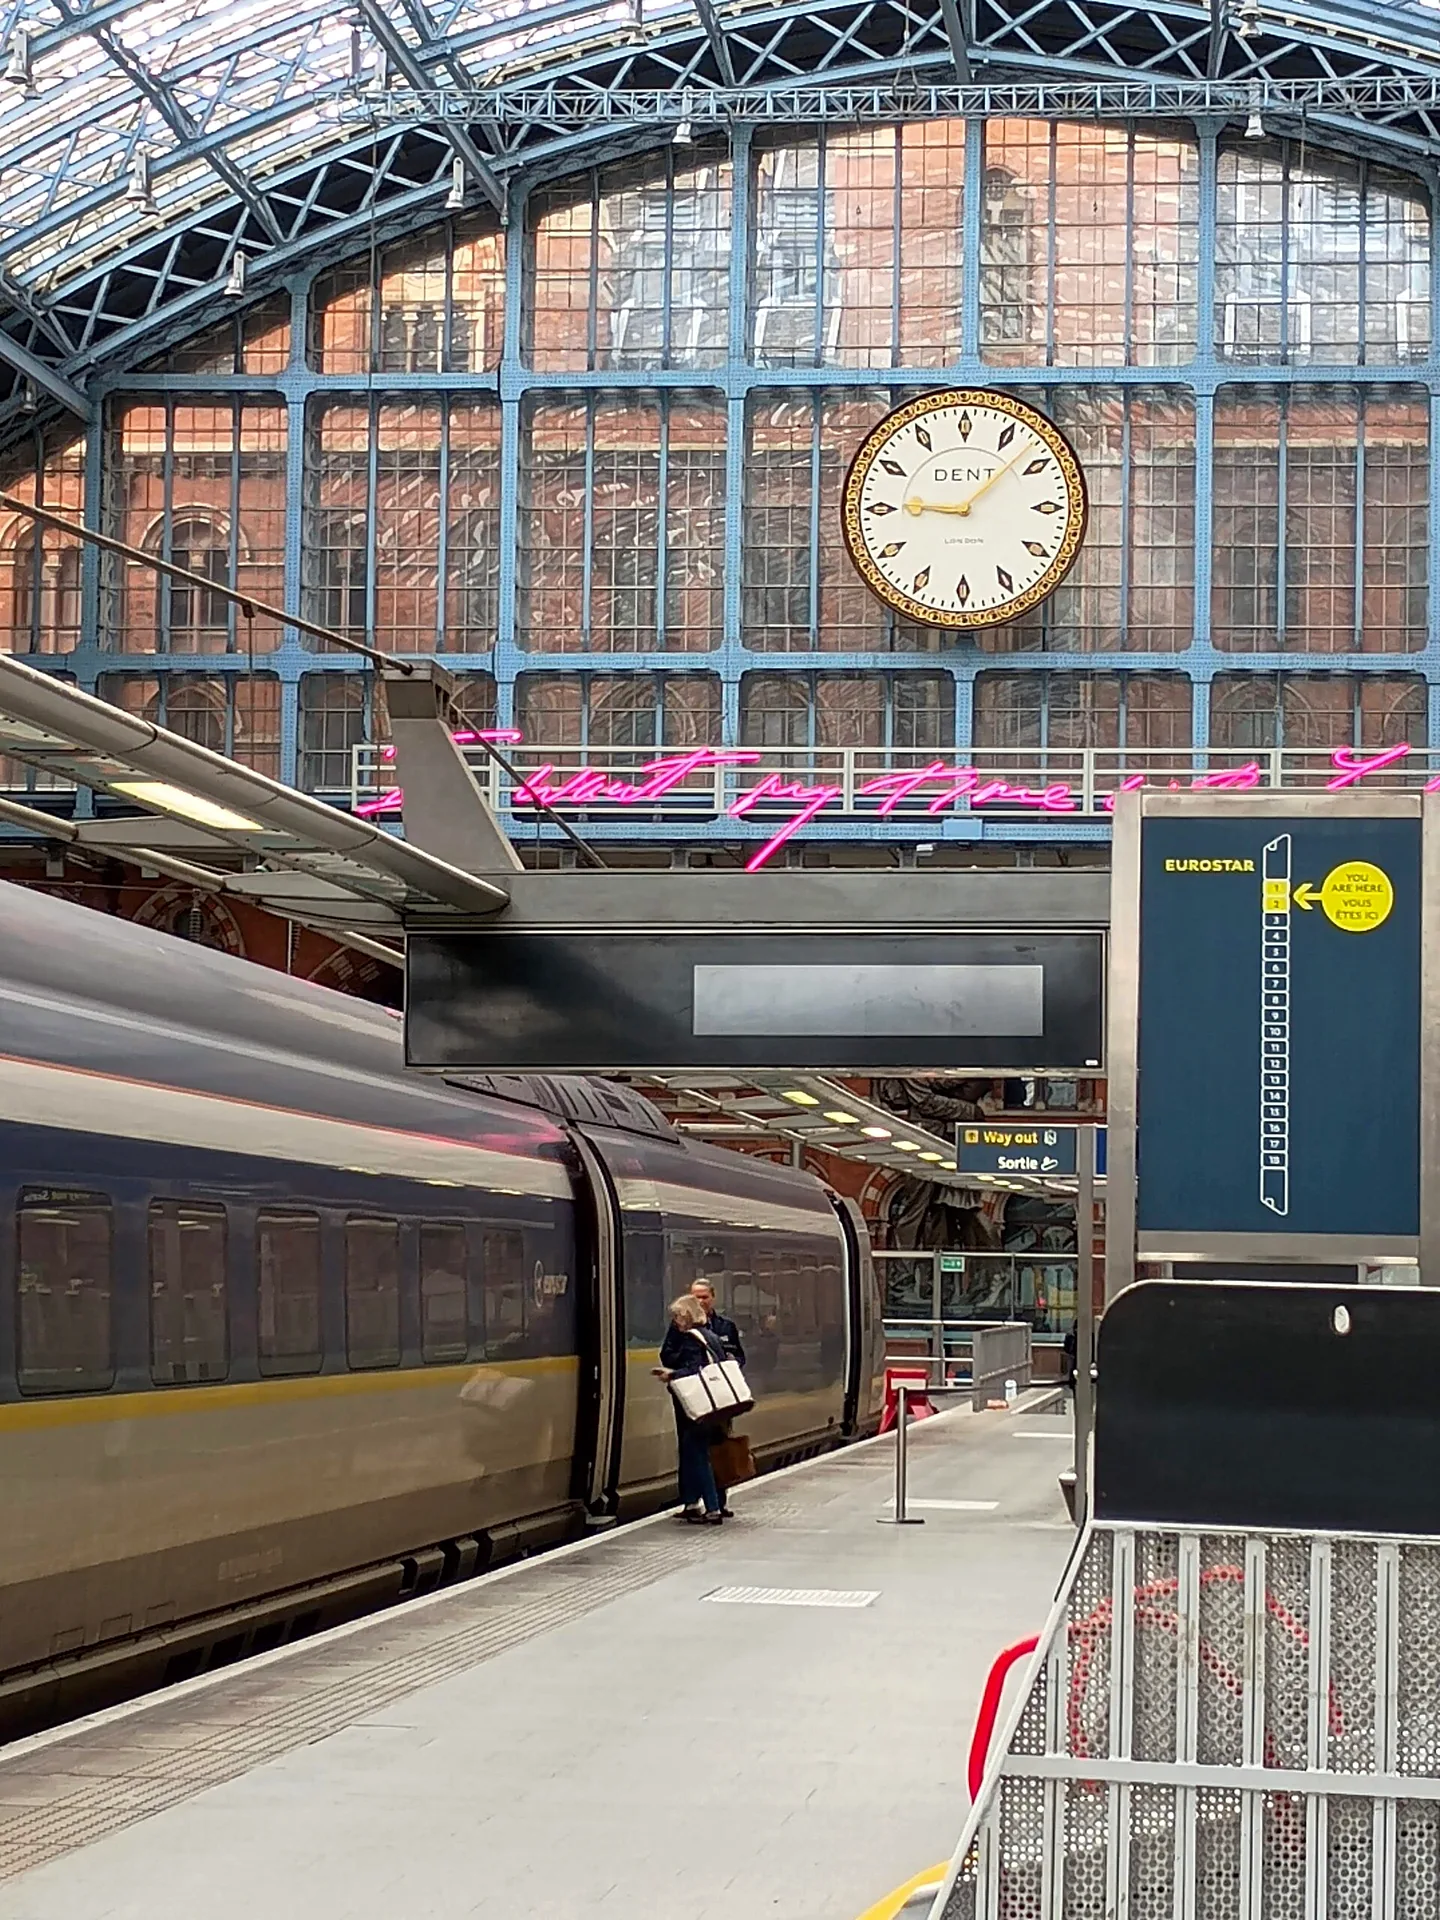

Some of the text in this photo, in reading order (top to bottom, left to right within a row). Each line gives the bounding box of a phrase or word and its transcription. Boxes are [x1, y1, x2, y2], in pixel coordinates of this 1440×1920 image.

[934, 468, 996, 482] DENT
[944, 537, 984, 545] LONDON
[727, 773, 842, 873] my
[1165, 859, 1255, 872] EUROSTAR
[1346, 874, 1369, 882] YOU
[1331, 884, 1384, 892] ARE HERE
[1365, 911, 1379, 920] ICI
[1269, 1027, 1281, 1036] 10
[1270, 1043, 1280, 1052] 11
[1270, 1059, 1280, 1068] 12
[1269, 1092, 1281, 1100] 14
[1270, 1107, 1280, 1116] 15
[1269, 1123, 1280, 1132] 16
[983, 1131, 1038, 1146] Way out
[1269, 1139, 1280, 1148] 17
[998, 1156, 1038, 1170] Sortie
